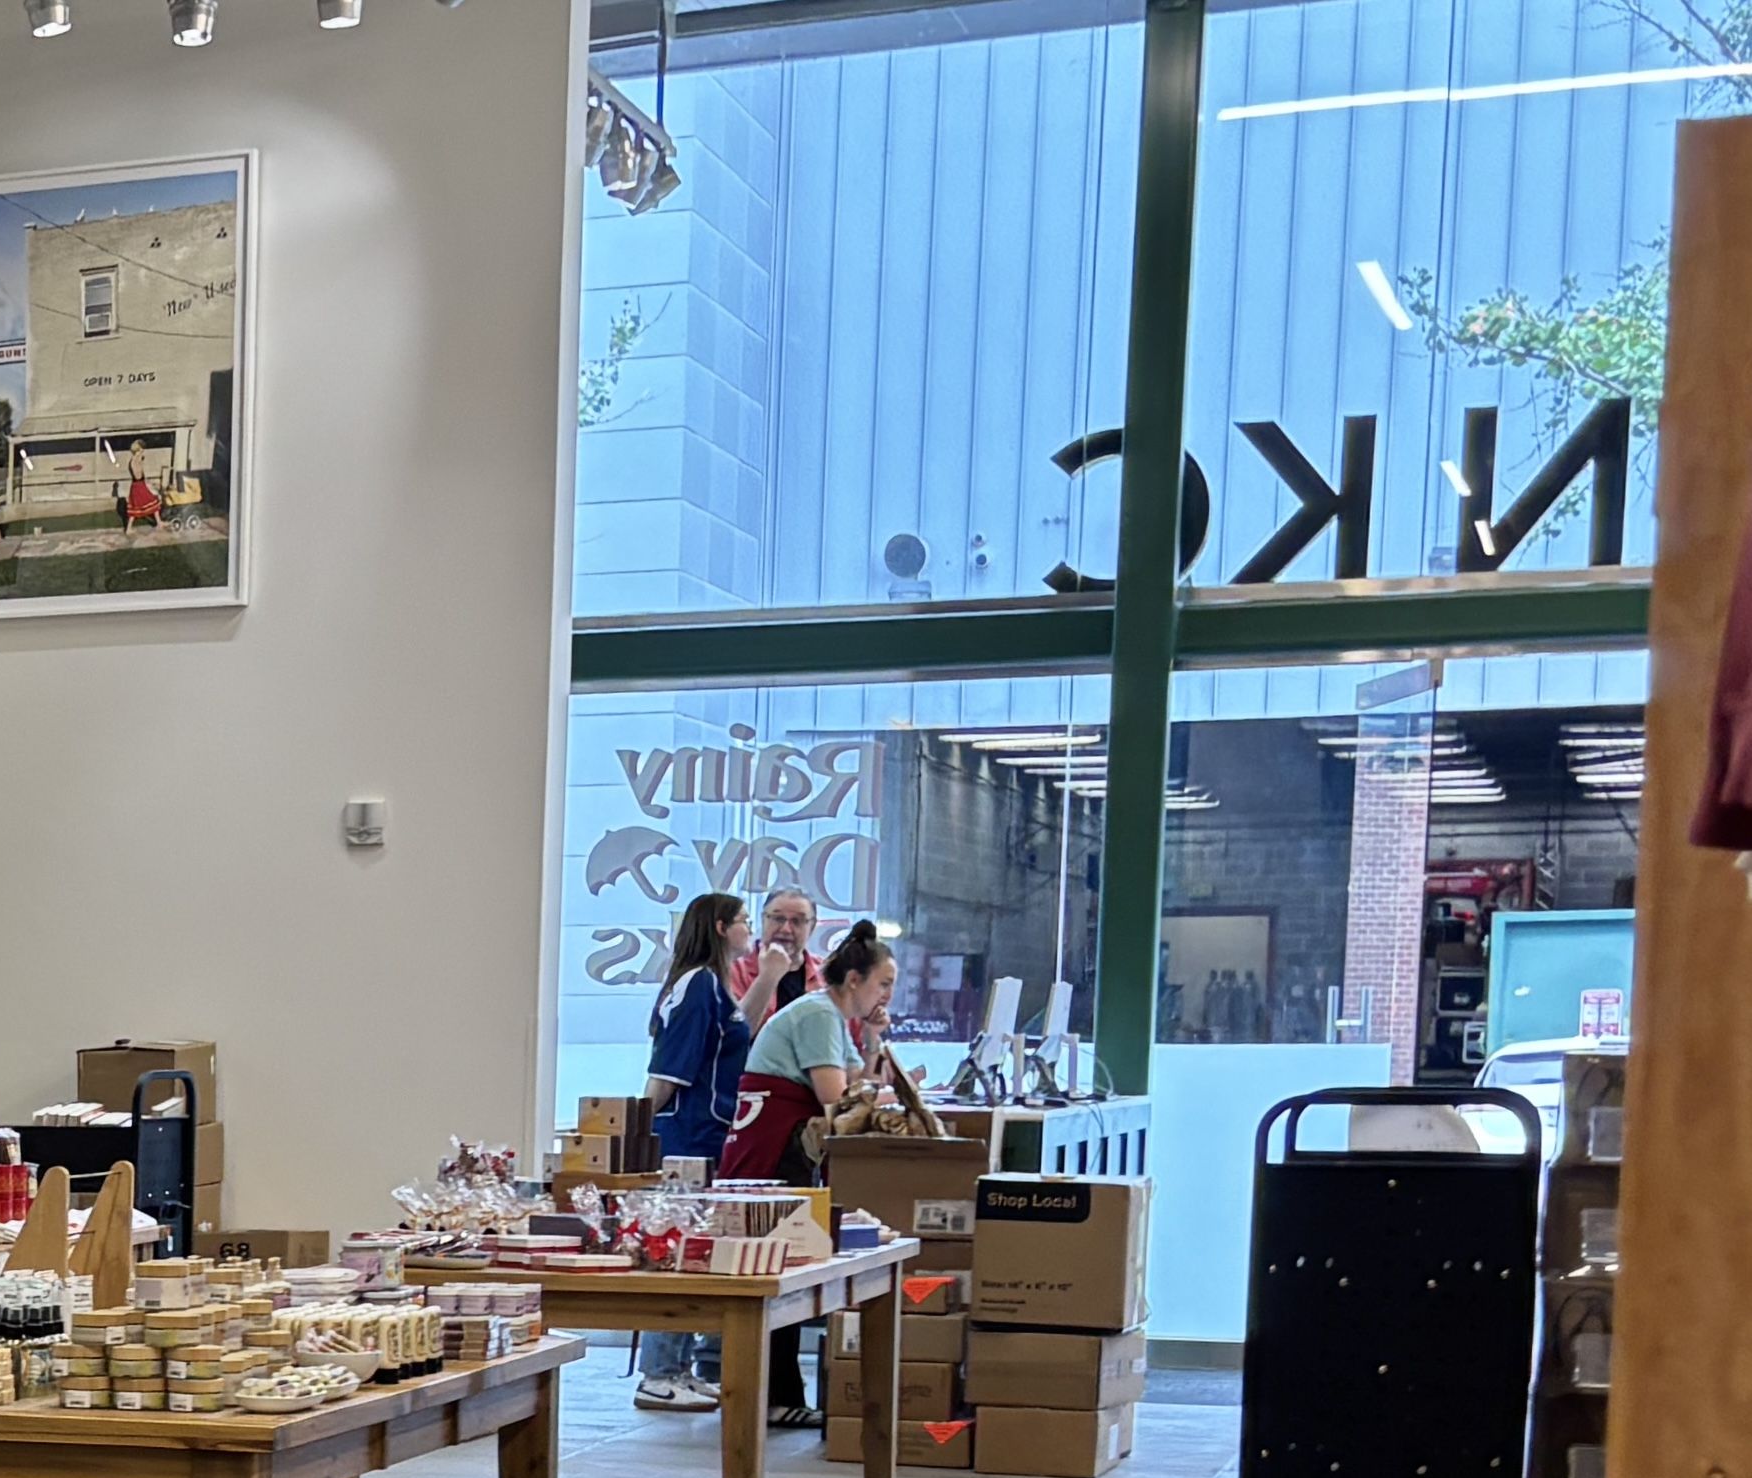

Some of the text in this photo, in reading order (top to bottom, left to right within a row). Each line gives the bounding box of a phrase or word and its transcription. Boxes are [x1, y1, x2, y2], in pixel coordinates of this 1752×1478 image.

[84, 371, 156, 387] OPEN 7 DAYS
[987, 1192, 1077, 1210] Shop Local
[219, 1242, 250, 1260] 68
